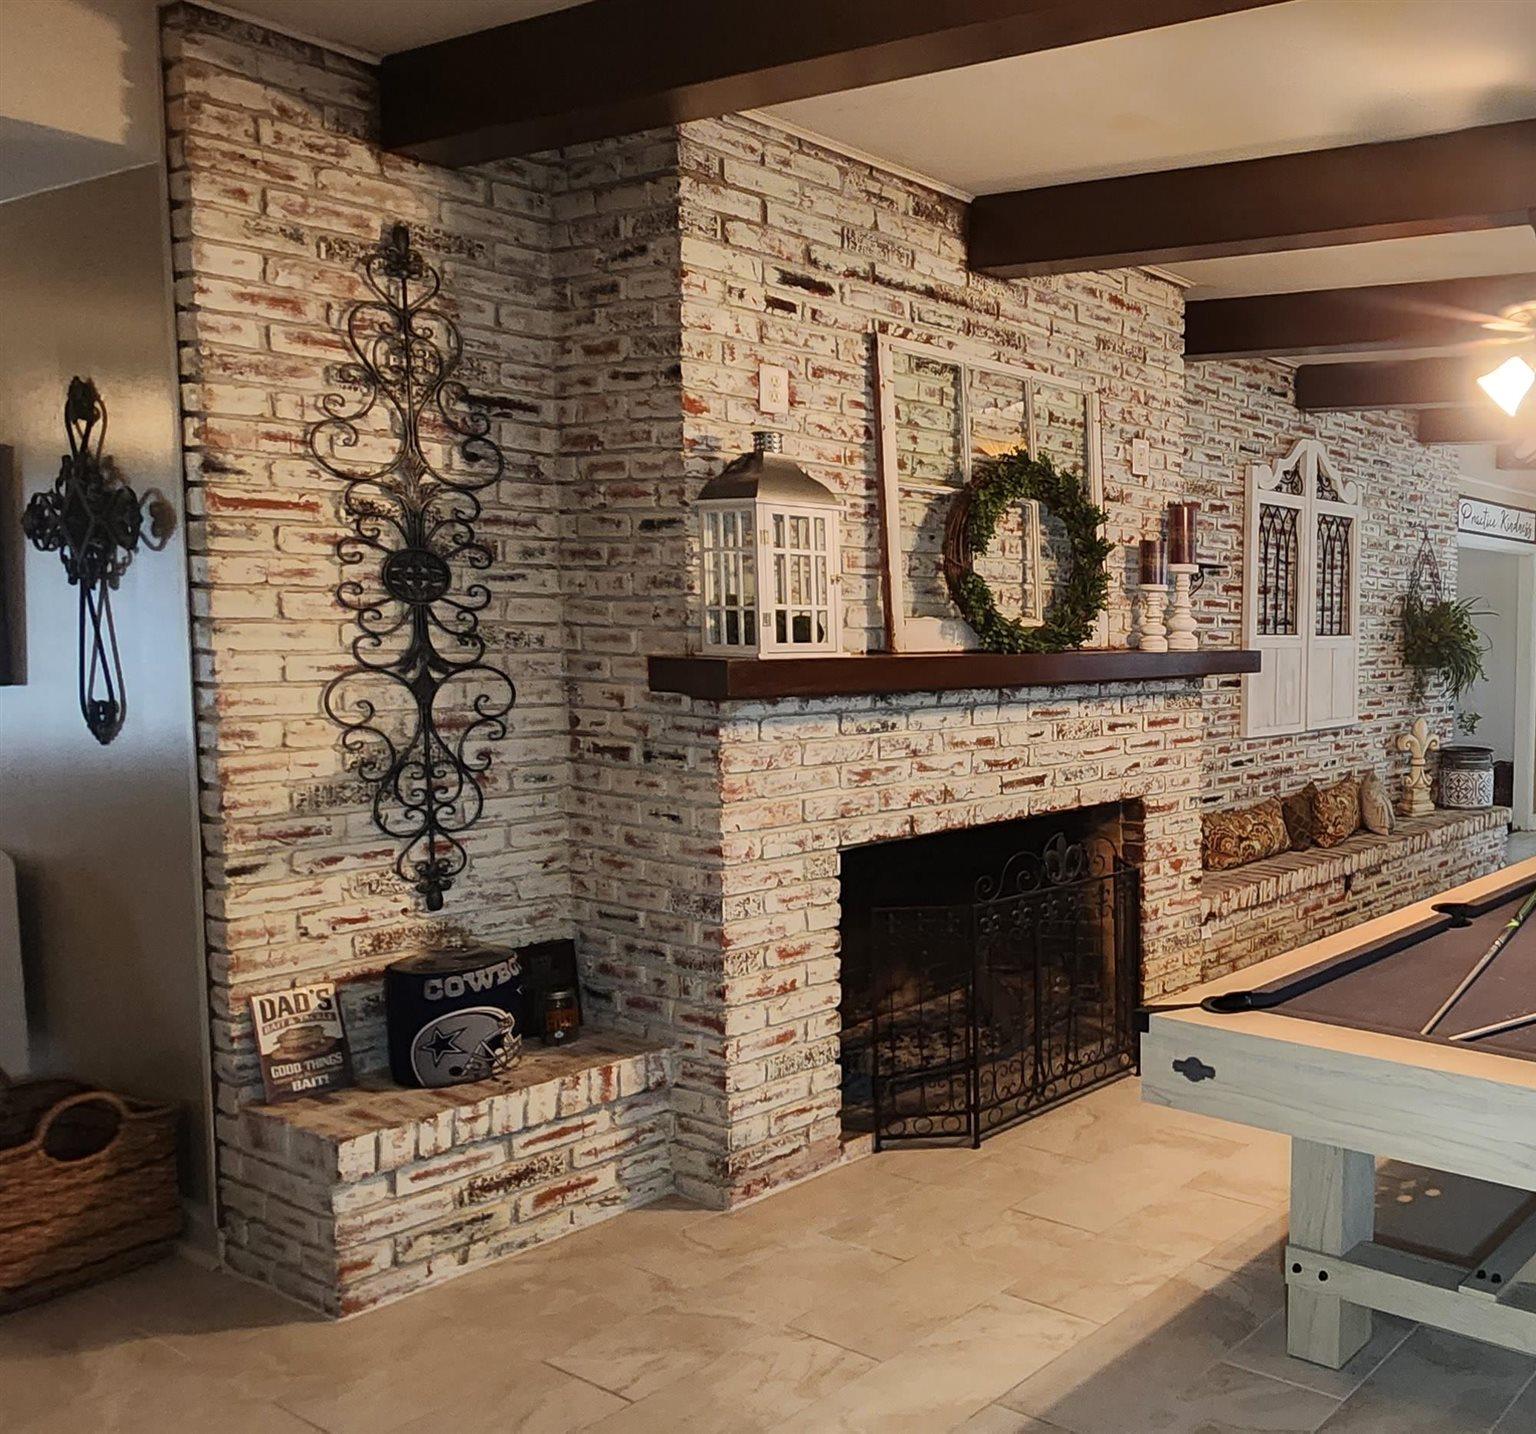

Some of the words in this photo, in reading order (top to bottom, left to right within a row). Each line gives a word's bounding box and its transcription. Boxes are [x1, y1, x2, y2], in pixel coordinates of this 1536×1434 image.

[423, 953, 522, 1001] COWBO
[259, 988, 333, 1024] DAD'S
[270, 1062, 302, 1079] GOOD
[302, 1051, 344, 1071] THINGS
[291, 1073, 330, 1093] BAIT!
